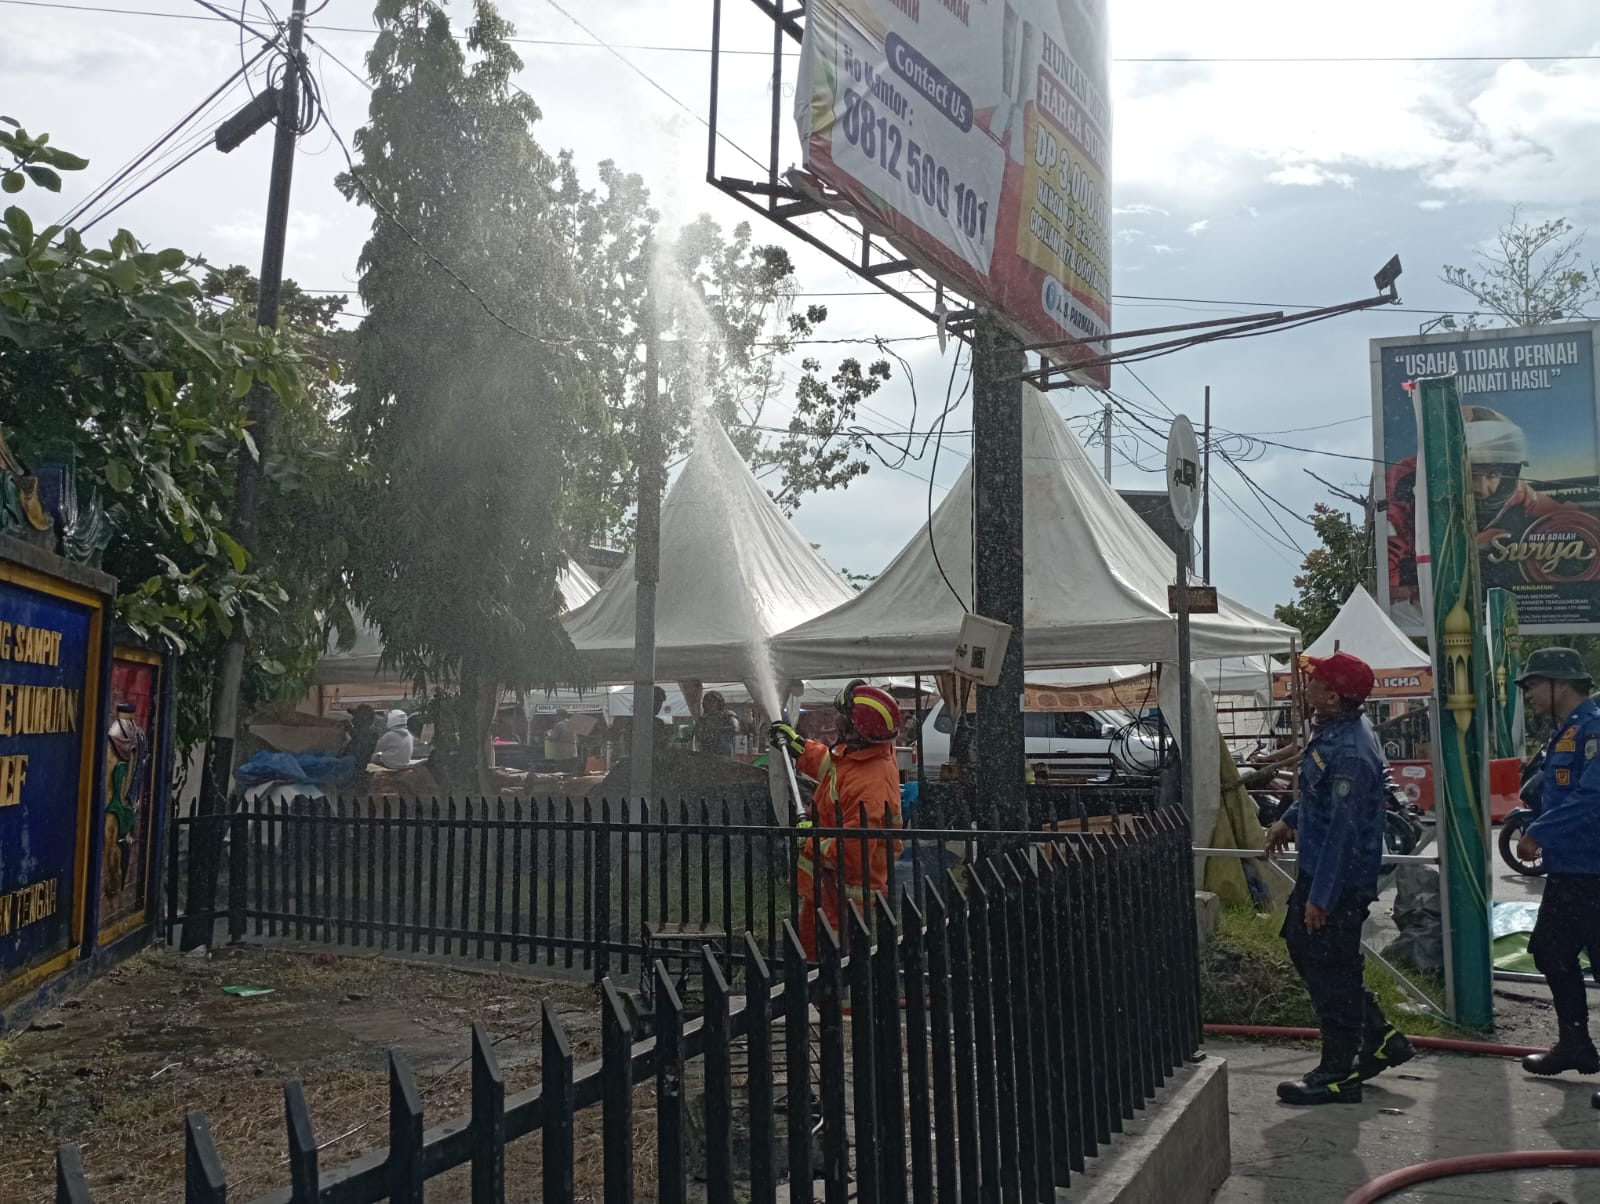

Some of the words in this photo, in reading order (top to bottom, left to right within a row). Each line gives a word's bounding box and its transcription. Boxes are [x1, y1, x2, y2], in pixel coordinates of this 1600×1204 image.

[895, 44, 948, 109] Contact
[951, 91, 967, 123] Us
[1041, 30, 1088, 107] HUNIAN
[1040, 74, 1083, 146] HARGA
[842, 87, 902, 182] 0812
[906, 139, 950, 218] 500
[954, 182, 988, 246] 101
[1034, 119, 1057, 176] DP
[1463, 347, 1509, 372] TIDAK
[1515, 342, 1578, 367] PERNAH
[1488, 533, 1597, 573] Surya
[1547, 533, 1576, 541] ADALAH
[14, 624, 62, 667] SAMPIT
[1384, 676, 1421, 687] ICHA
[17, 877, 57, 929] TENGAH
